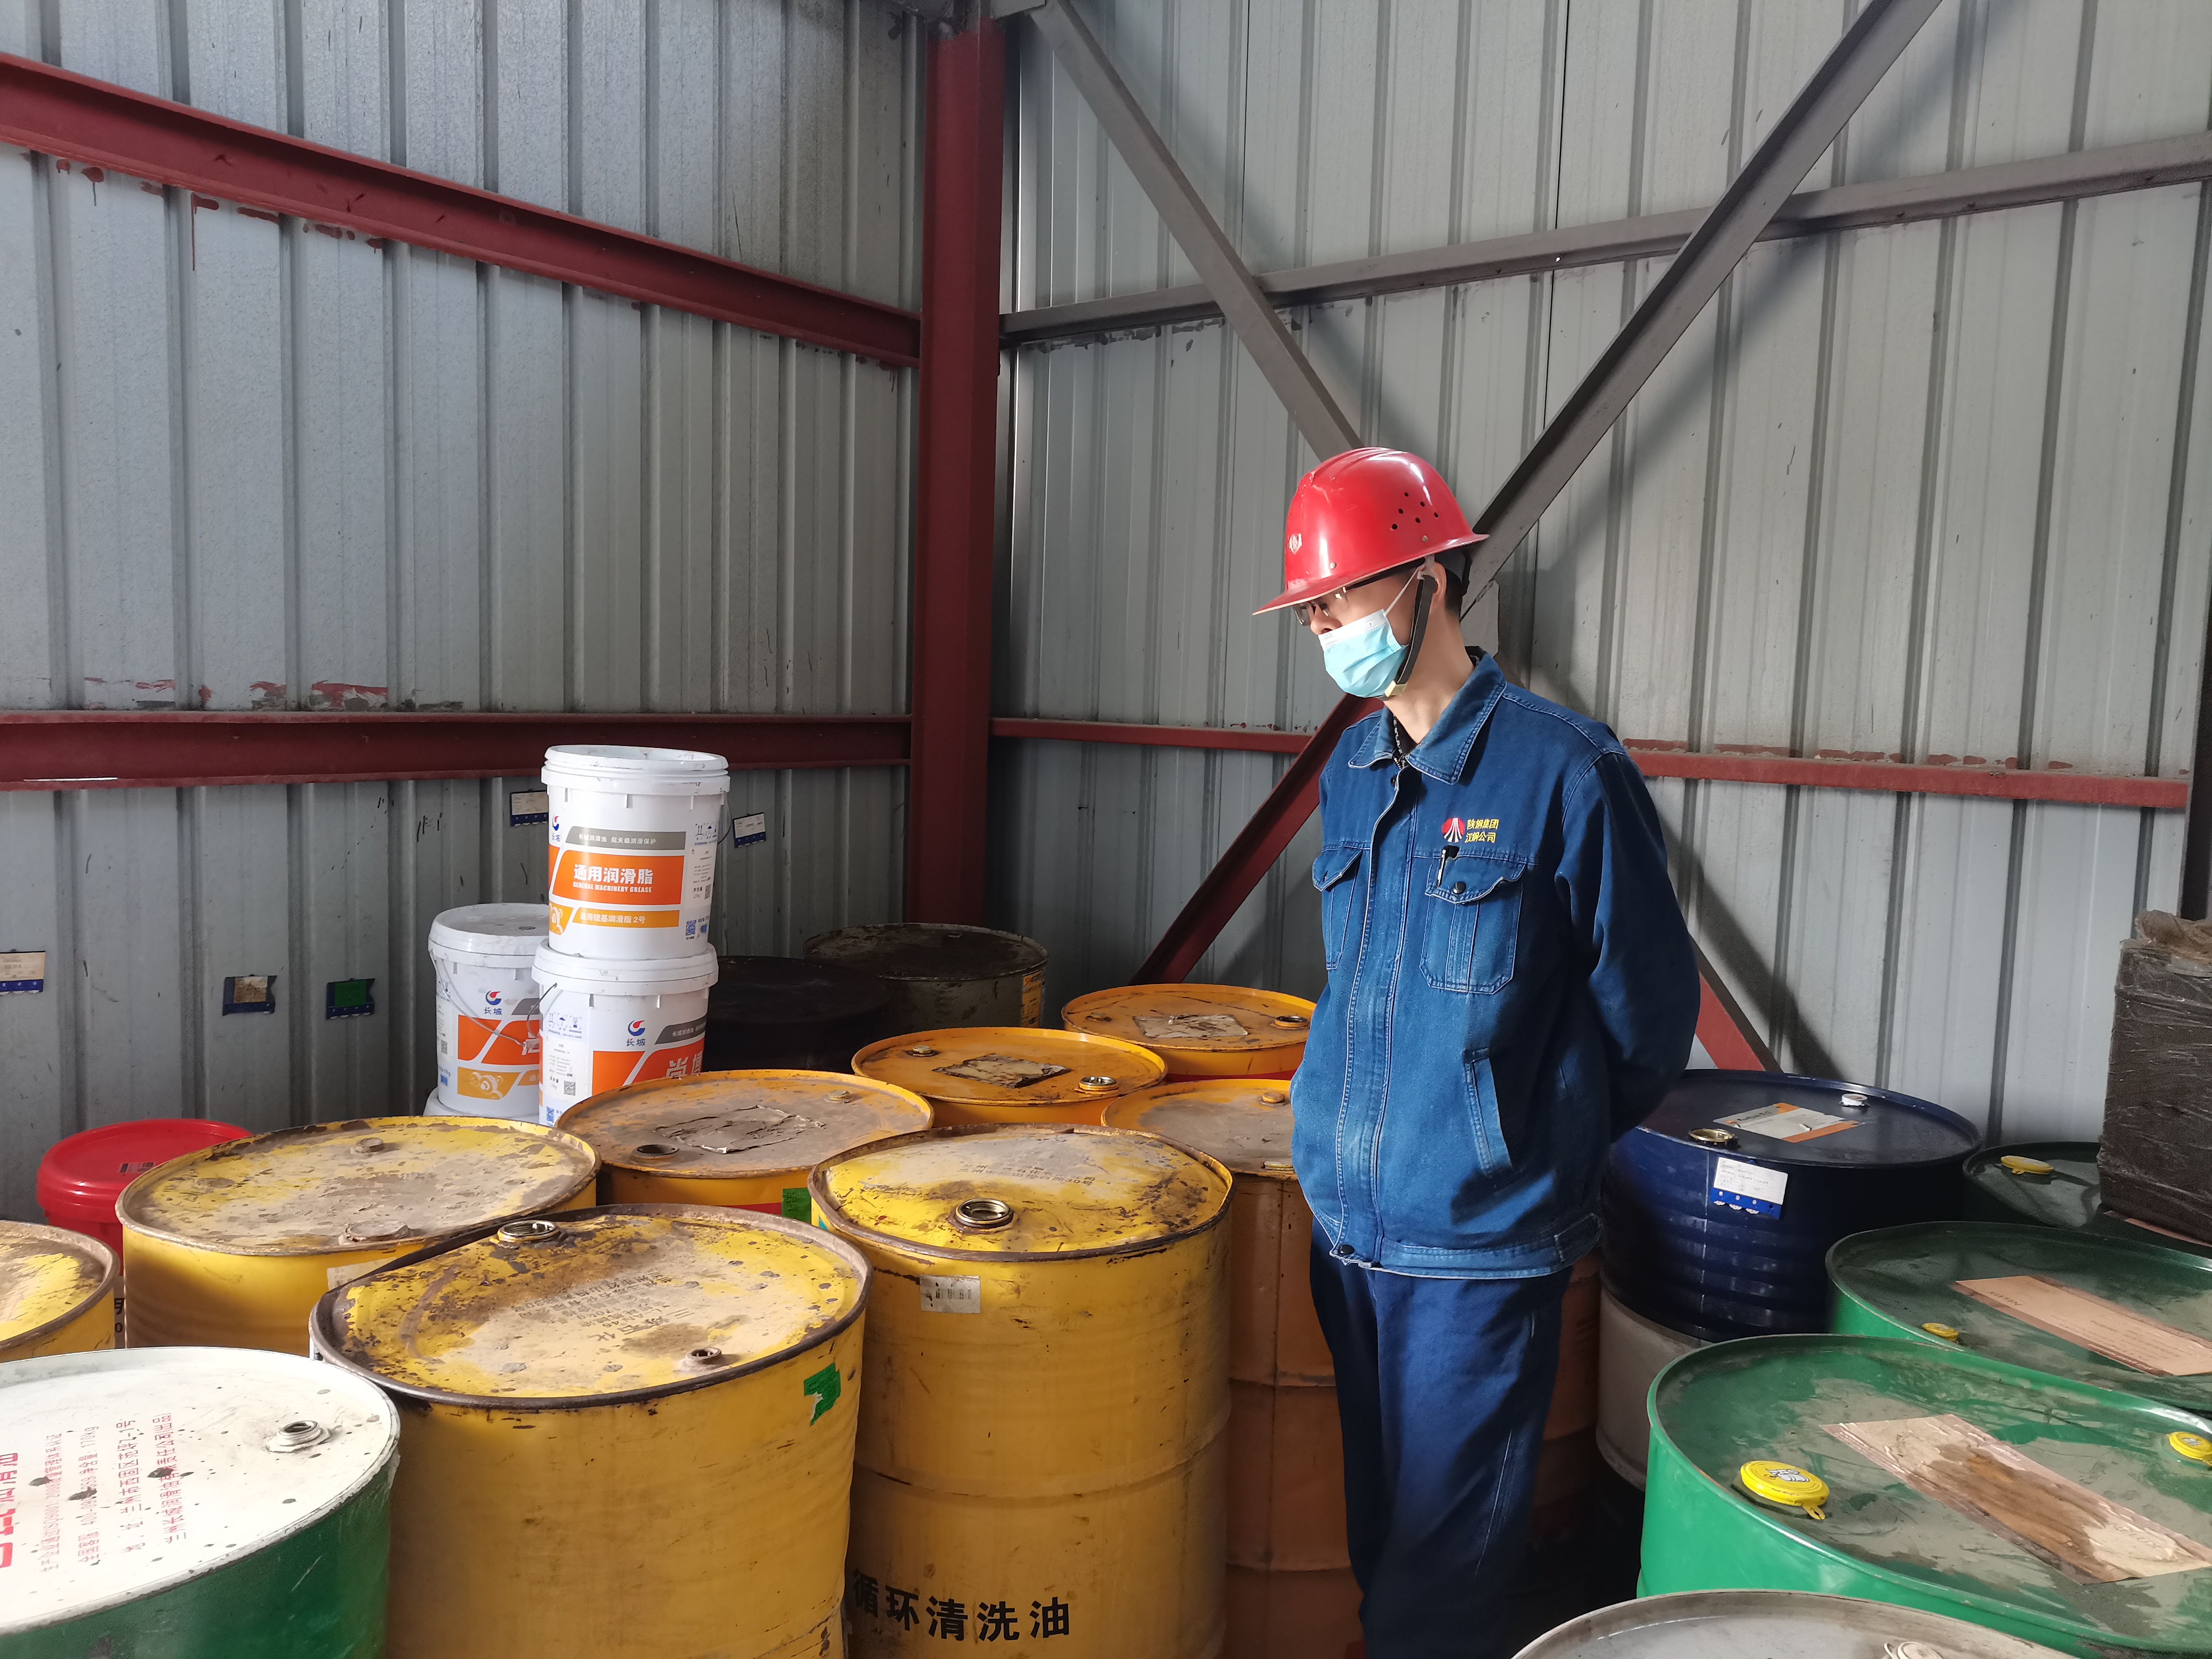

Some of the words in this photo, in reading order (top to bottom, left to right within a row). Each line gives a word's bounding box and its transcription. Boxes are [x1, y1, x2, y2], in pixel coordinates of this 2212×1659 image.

[1467, 818, 1499, 830] 陕钢集团
[573, 864, 653, 885] 通用润滑脂
[573, 882, 594, 890] GENERAL
[595, 884, 628, 892] MACHINERY
[483, 1007, 502, 1015] 长城
[626, 1038, 646, 1046] 长城
[853, 1568, 1070, 1642] 循环清洗油
